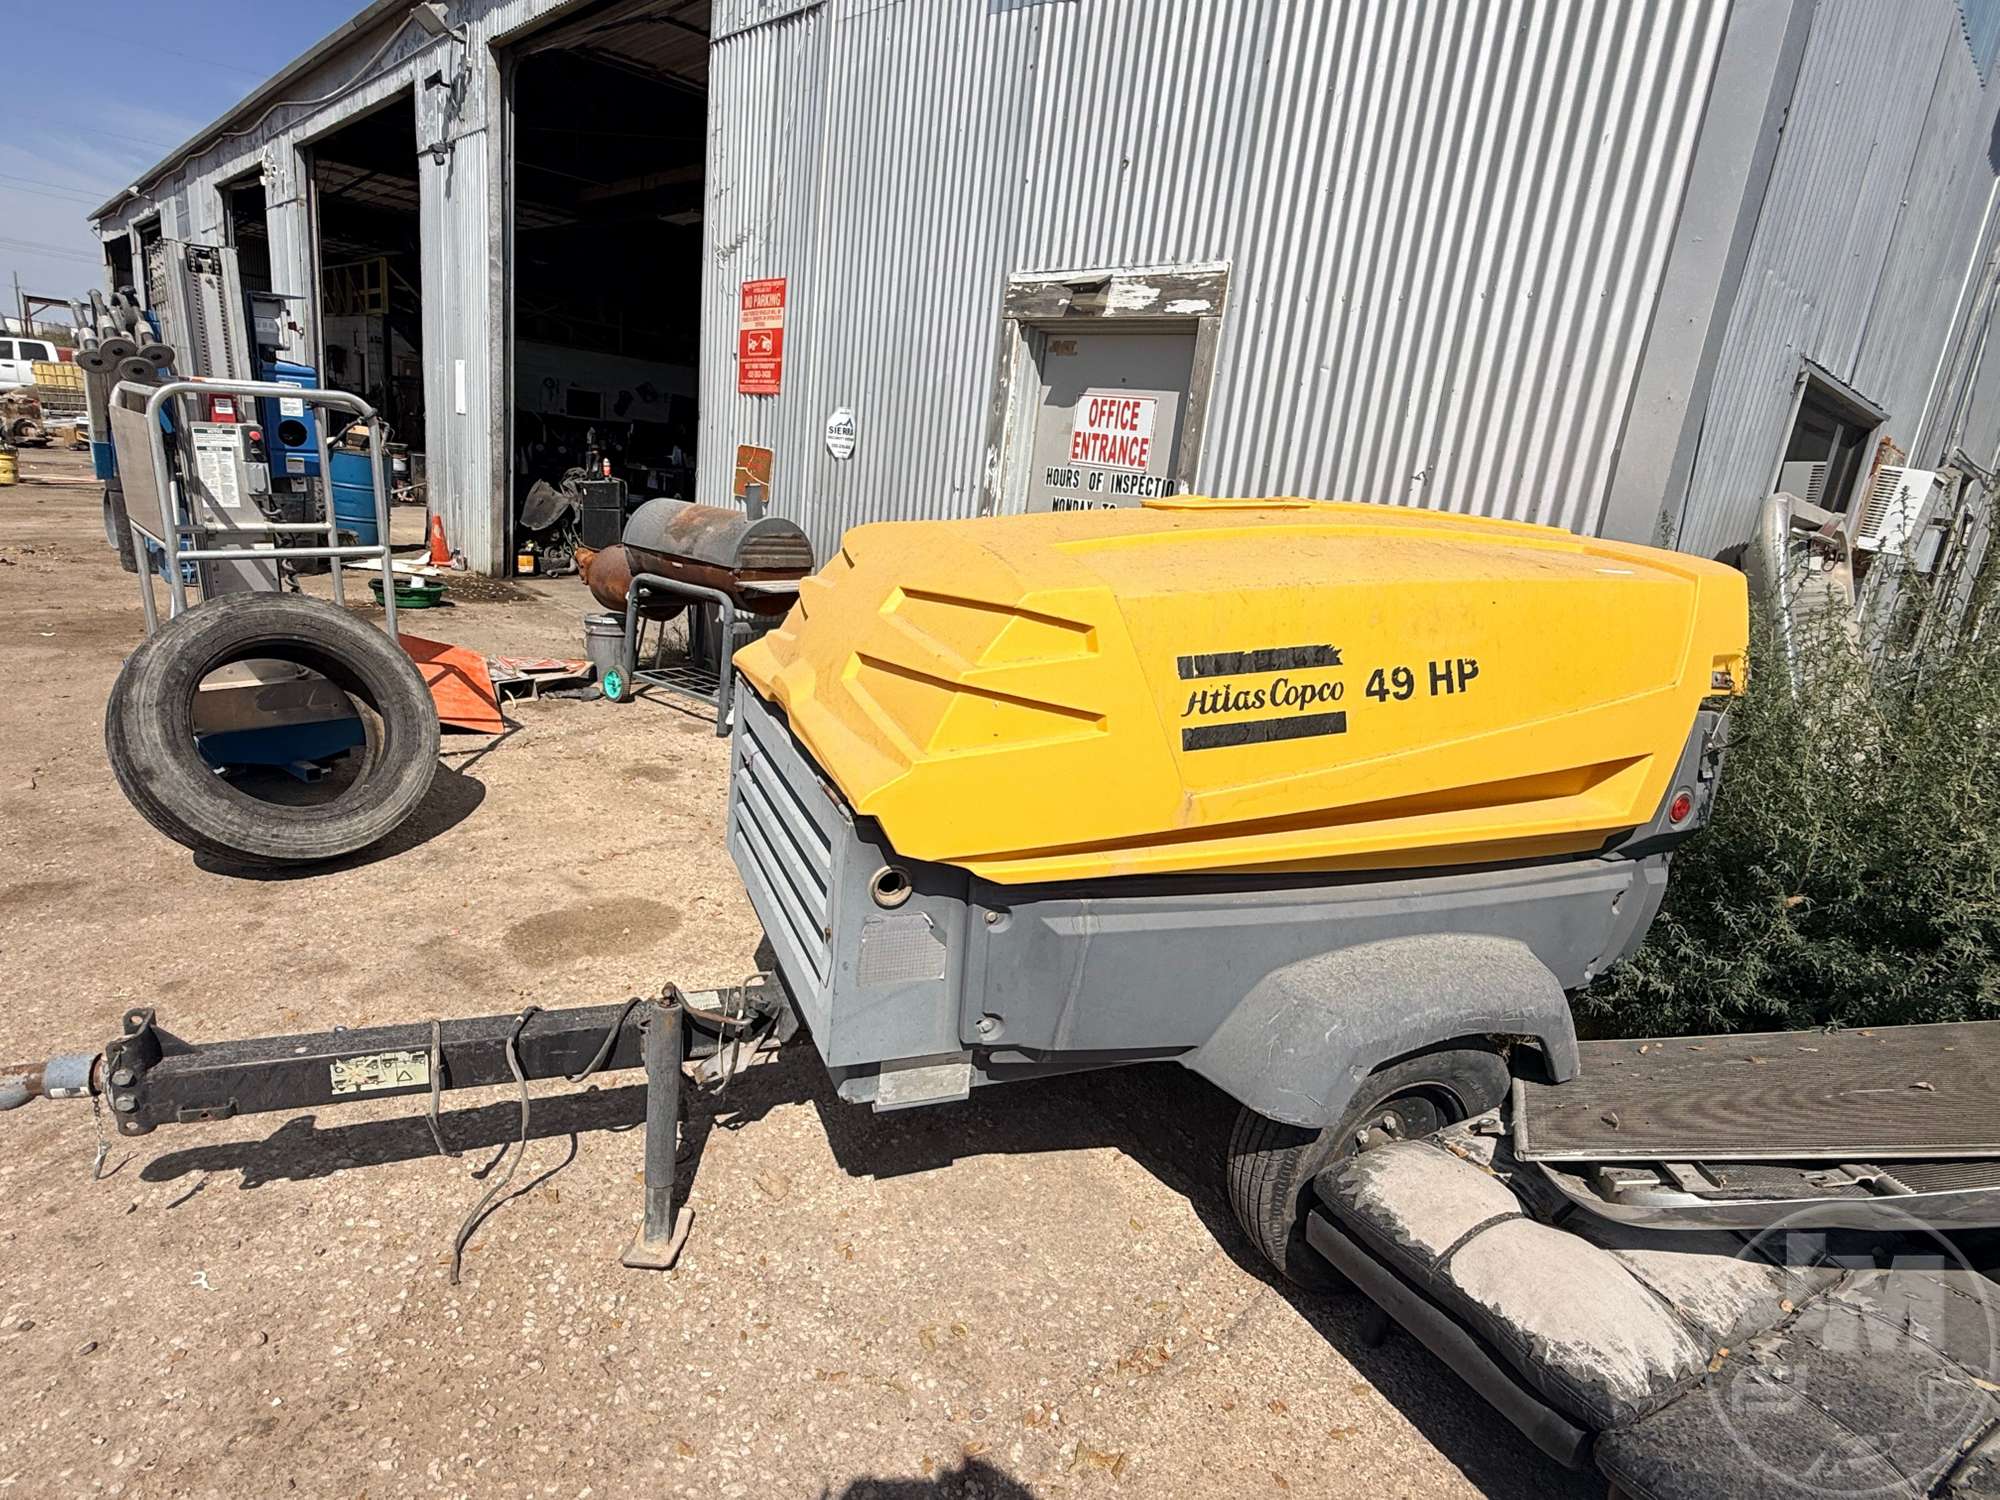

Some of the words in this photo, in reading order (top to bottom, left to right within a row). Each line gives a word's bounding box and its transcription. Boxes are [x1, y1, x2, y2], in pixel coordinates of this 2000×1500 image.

[754, 292, 781, 308] PARKING
[1089, 398, 1141, 431] OFFICE
[1072, 431, 1149, 468] ENTRANCE
[1046, 467, 1080, 488] HOURS
[1089, 472, 1103, 491] OF
[1111, 474, 1175, 498] INSPECTIO
[1365, 666, 1415, 702] 49
[1429, 658, 1479, 696] HP
